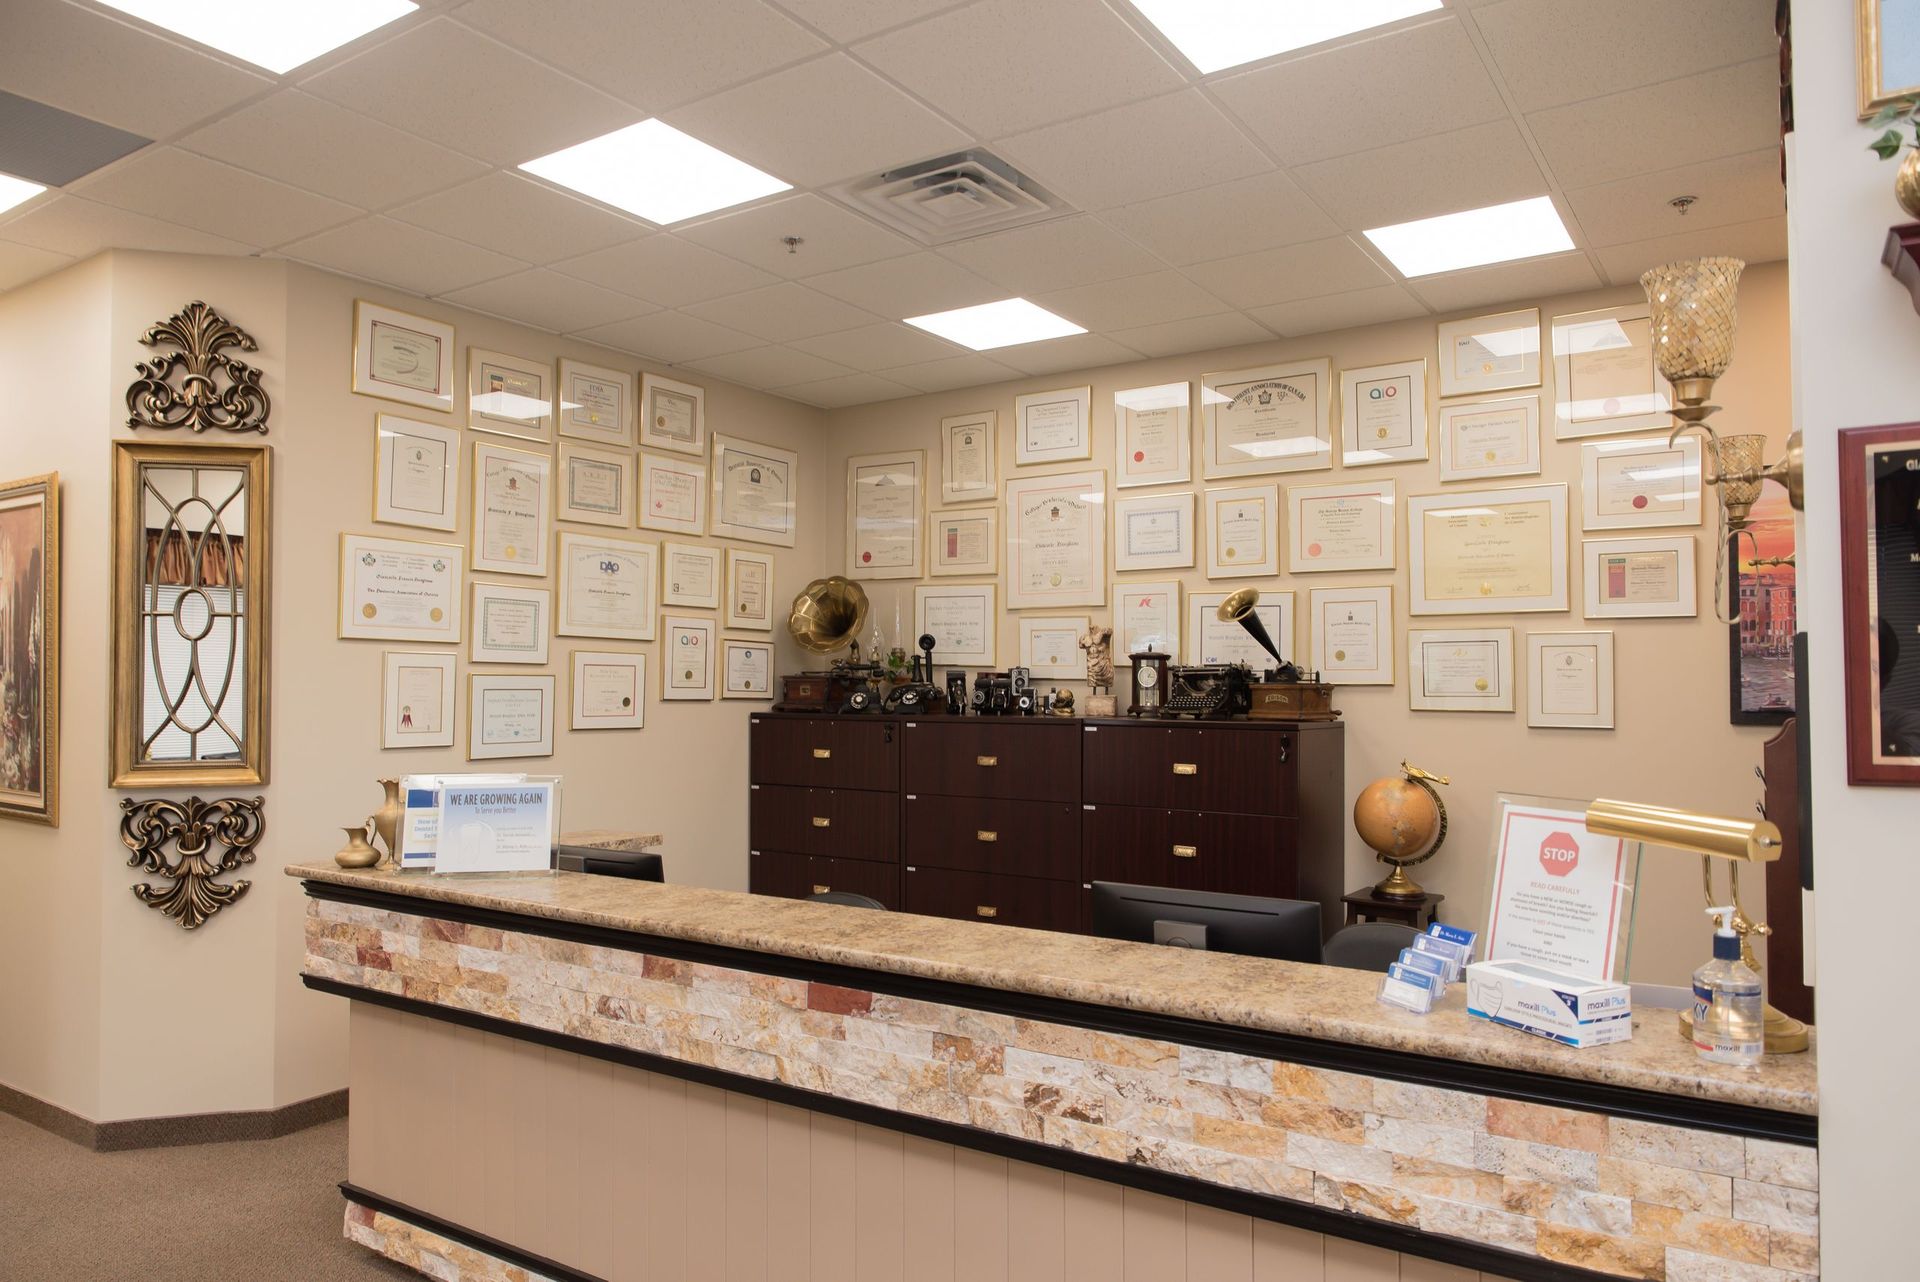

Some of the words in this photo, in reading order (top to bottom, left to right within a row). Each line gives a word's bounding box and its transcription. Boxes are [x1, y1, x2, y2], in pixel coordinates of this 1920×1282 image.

[1250, 382, 1282, 394] ASSOCIATION
[1288, 383, 1306, 401] CANADA
[450, 794, 462, 806] WE
[464, 794, 477, 805] ARE
[480, 793, 517, 805] GROWING
[519, 793, 542, 804] AGAIN
[1544, 848, 1576, 862] STOP
[1531, 881, 1546, 889] READ
[1547, 884, 1580, 895] CAREFULLY
[1518, 1001, 1540, 1012] maxill
[1541, 1005, 1556, 1016] Plus
[1588, 998, 1610, 1010] maxill
[1612, 996, 1626, 1006] Plus
[1715, 1044, 1740, 1052] maxill
